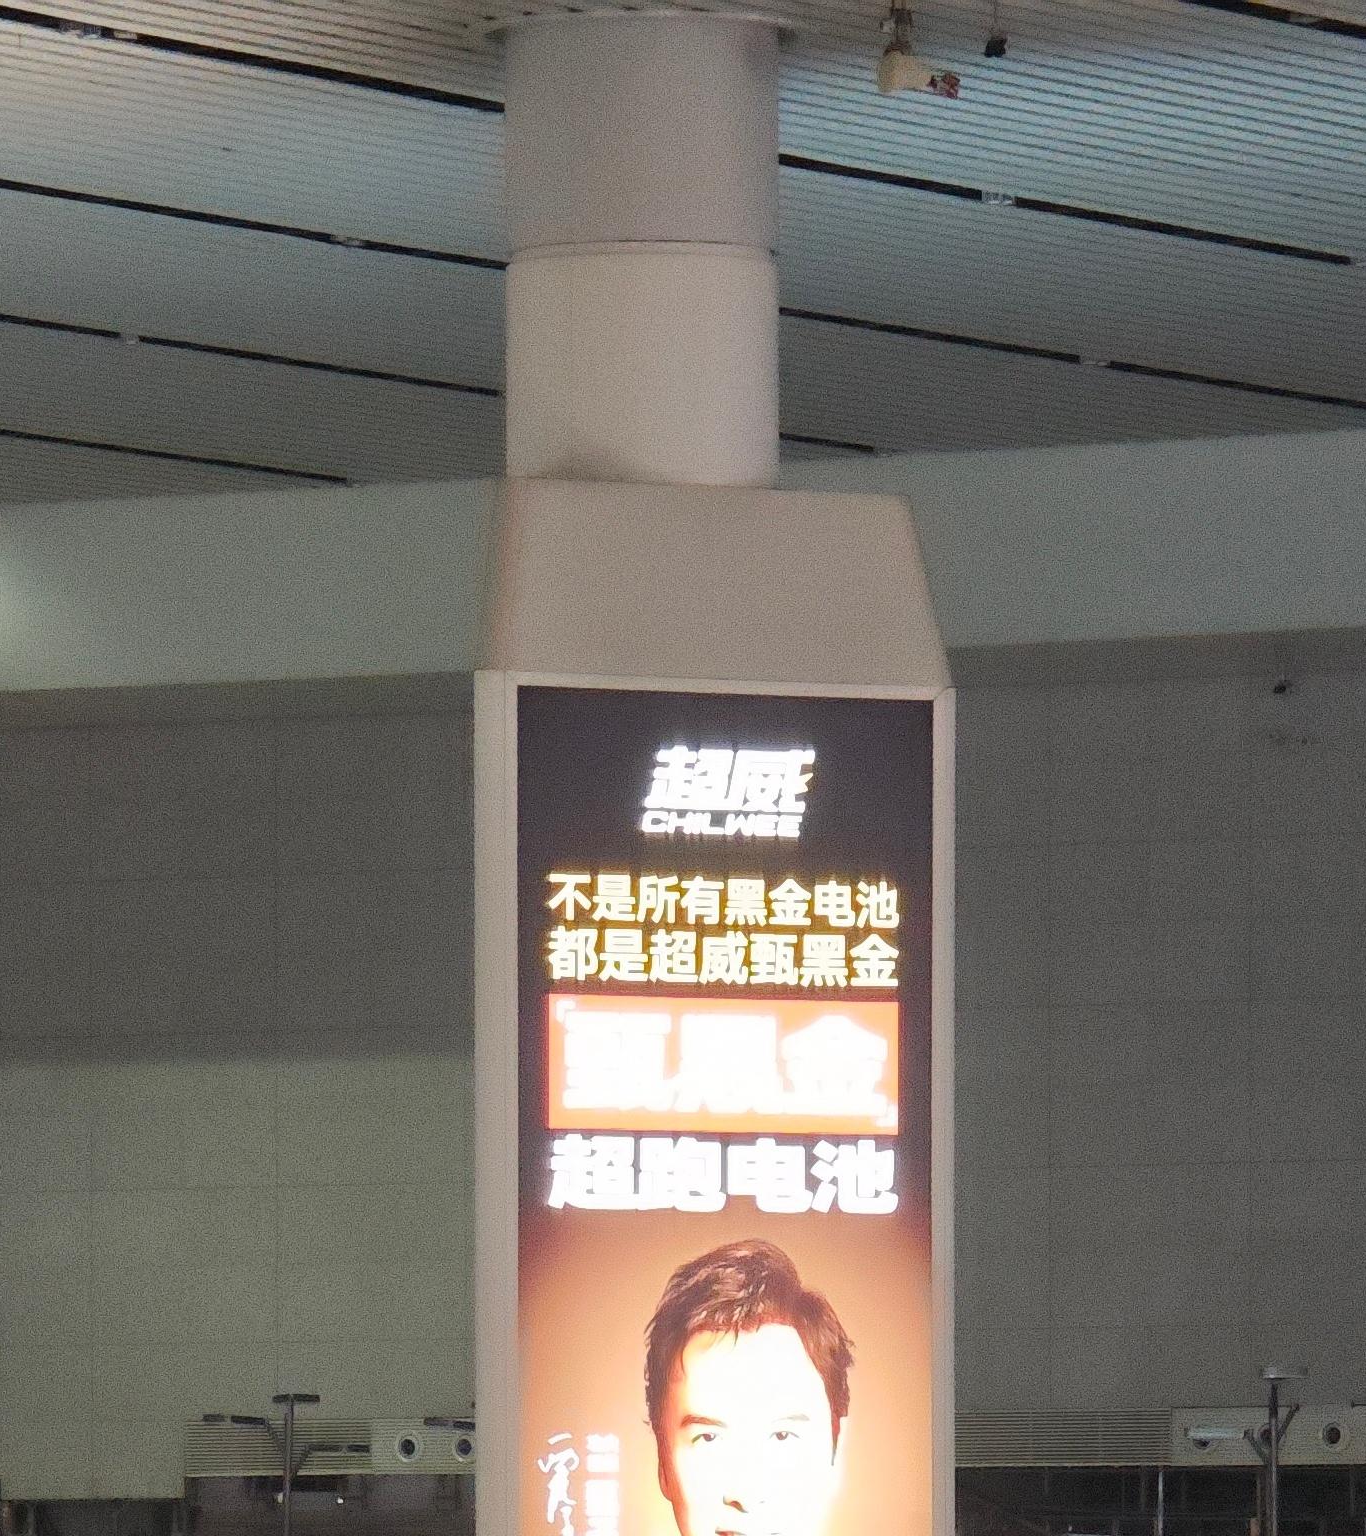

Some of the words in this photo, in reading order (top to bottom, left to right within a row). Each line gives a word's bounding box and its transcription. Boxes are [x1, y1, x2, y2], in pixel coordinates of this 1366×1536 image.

[643, 744, 816, 813] 超威
[641, 810, 802, 838] CHILWEE
[547, 872, 900, 929] 不是所有黑金电池
[547, 929, 900, 988] 都是超威甄黑金
[547, 1134, 899, 1214] 超跑电池
